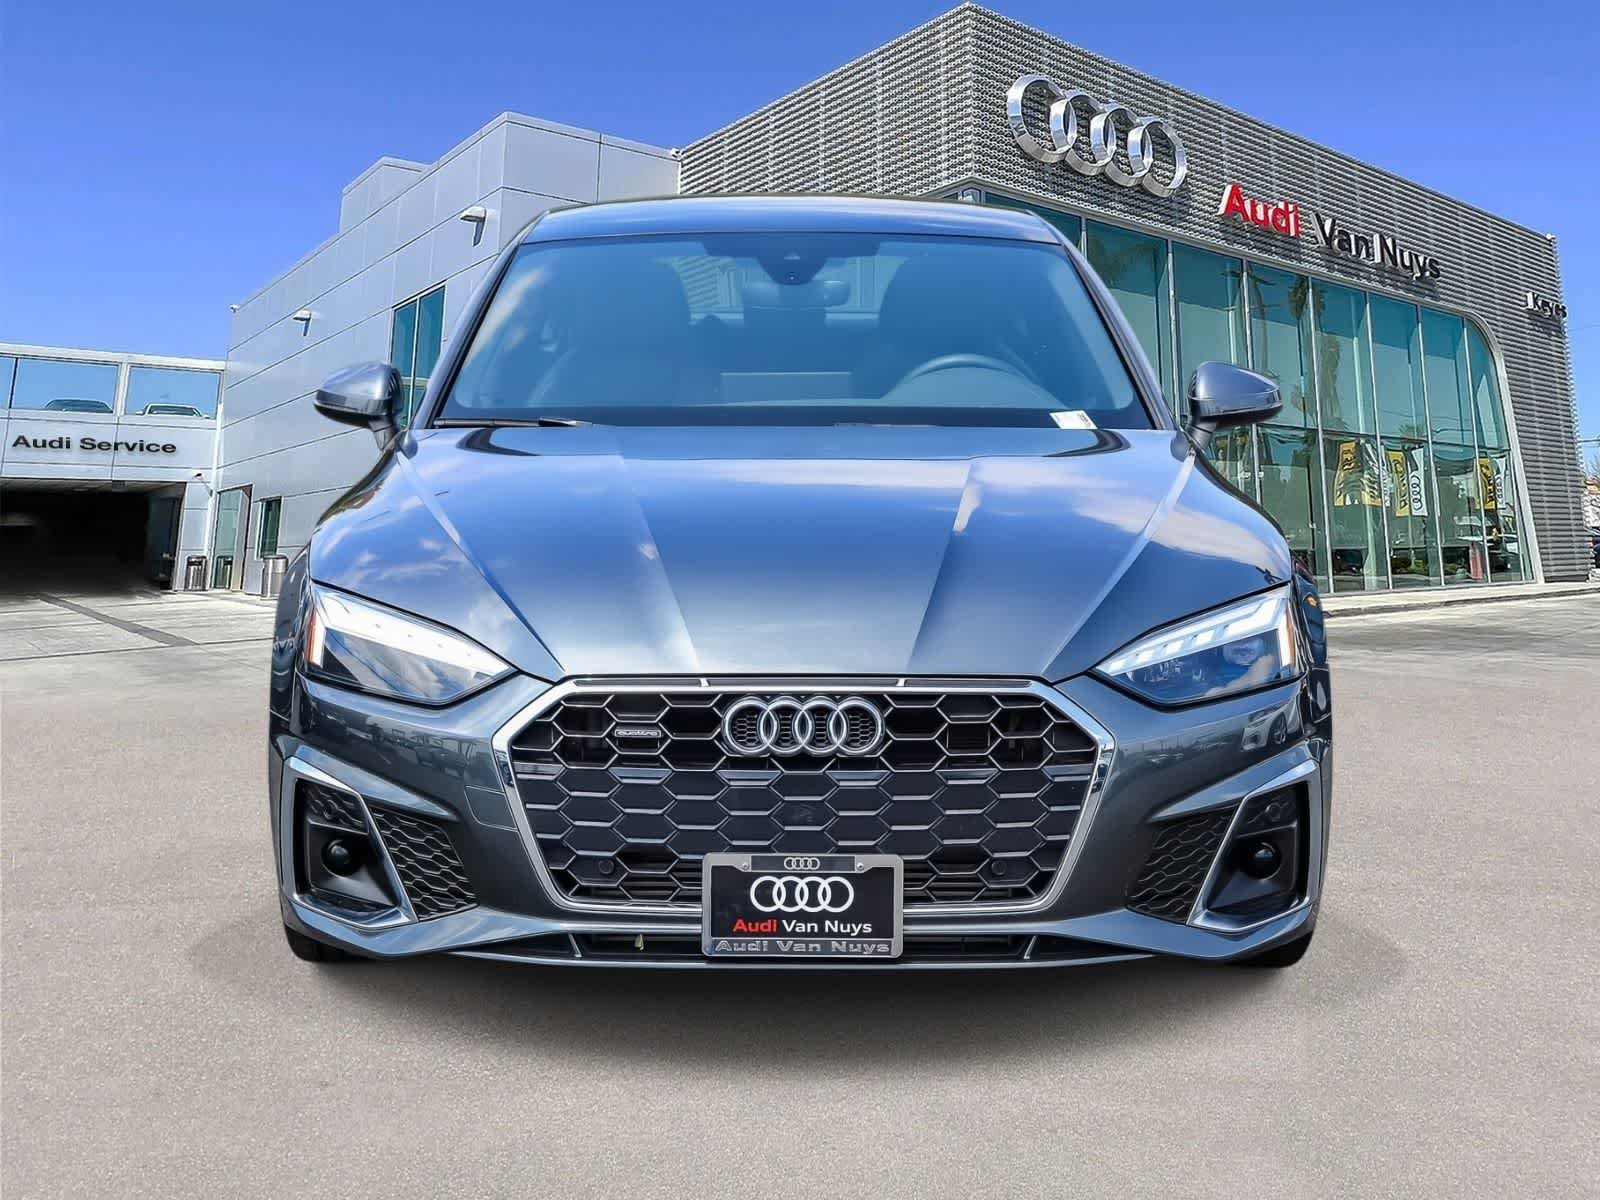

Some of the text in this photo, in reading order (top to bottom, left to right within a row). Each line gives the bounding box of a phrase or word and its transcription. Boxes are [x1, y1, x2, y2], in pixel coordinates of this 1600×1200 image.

[1217, 182, 1442, 281] Audi Van Nuys
[12, 435, 177, 453] Audi Service
[732, 919, 873, 936] Audi Van Nuys
[714, 940, 890, 955] Audi Van Nuys
